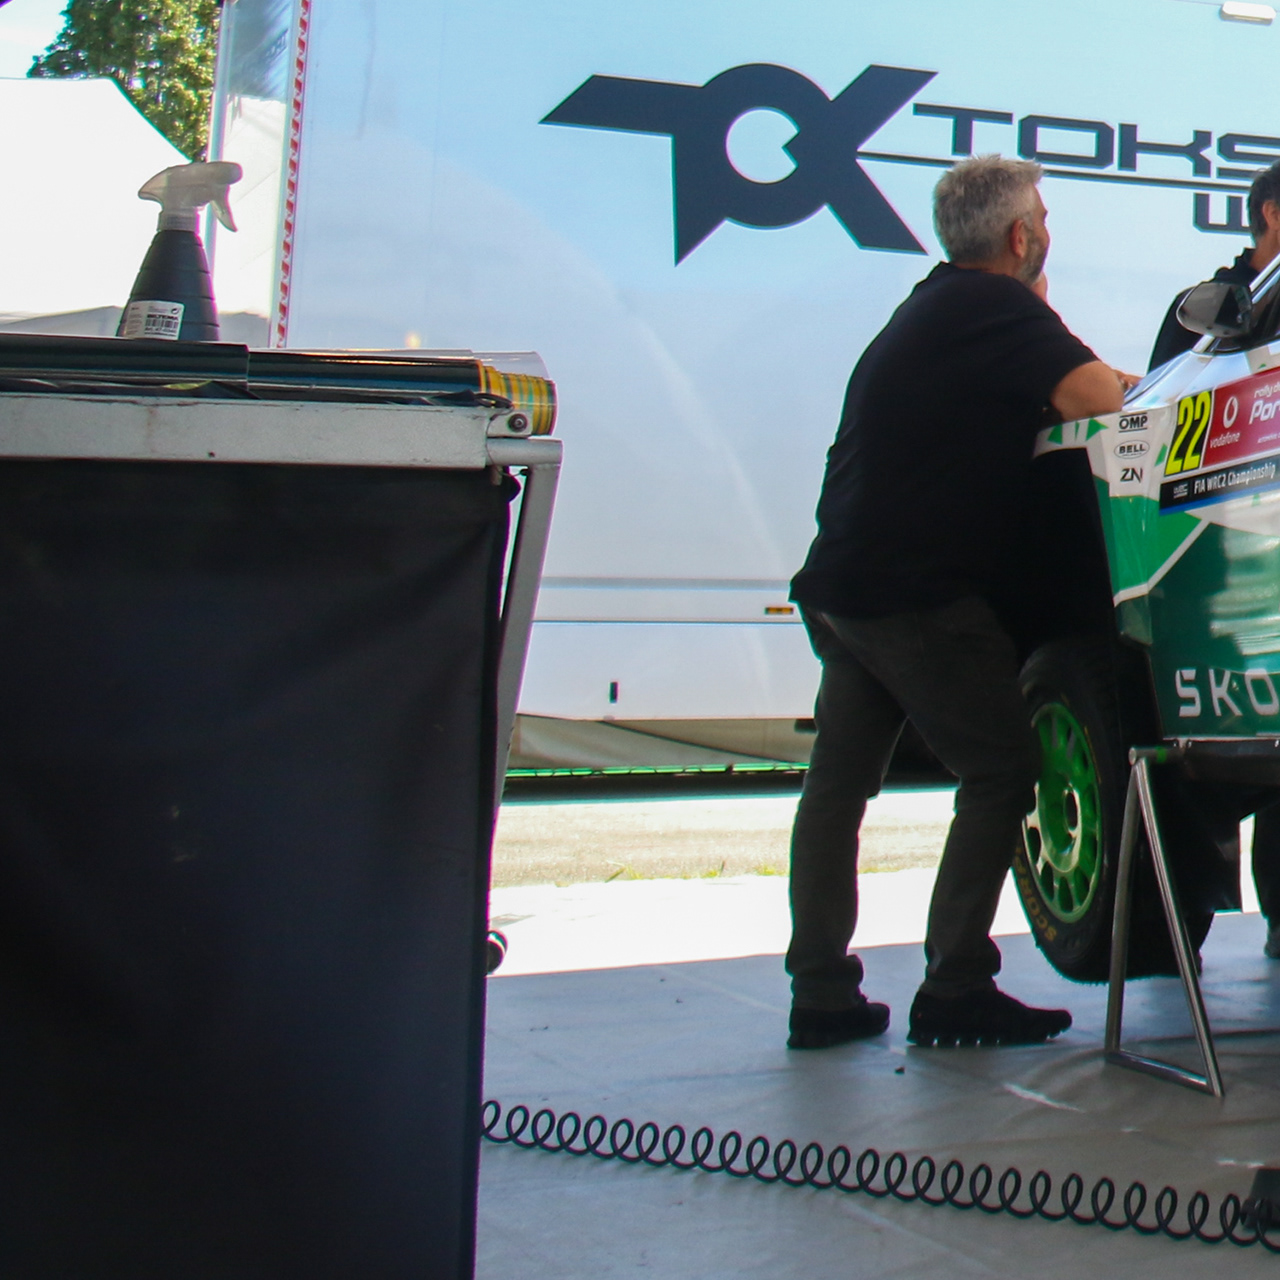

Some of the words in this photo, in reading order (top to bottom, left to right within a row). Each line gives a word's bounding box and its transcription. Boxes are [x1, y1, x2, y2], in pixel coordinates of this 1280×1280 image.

[1119, 415, 1148, 429] OMP
[1165, 391, 1211, 475] 22
[1209, 431, 1241, 448] vodafone
[1119, 444, 1146, 454] BELL
[1194, 480, 1205, 494] FIA
[1207, 476, 1226, 491] WRC2
[1228, 462, 1276, 486] Championship
